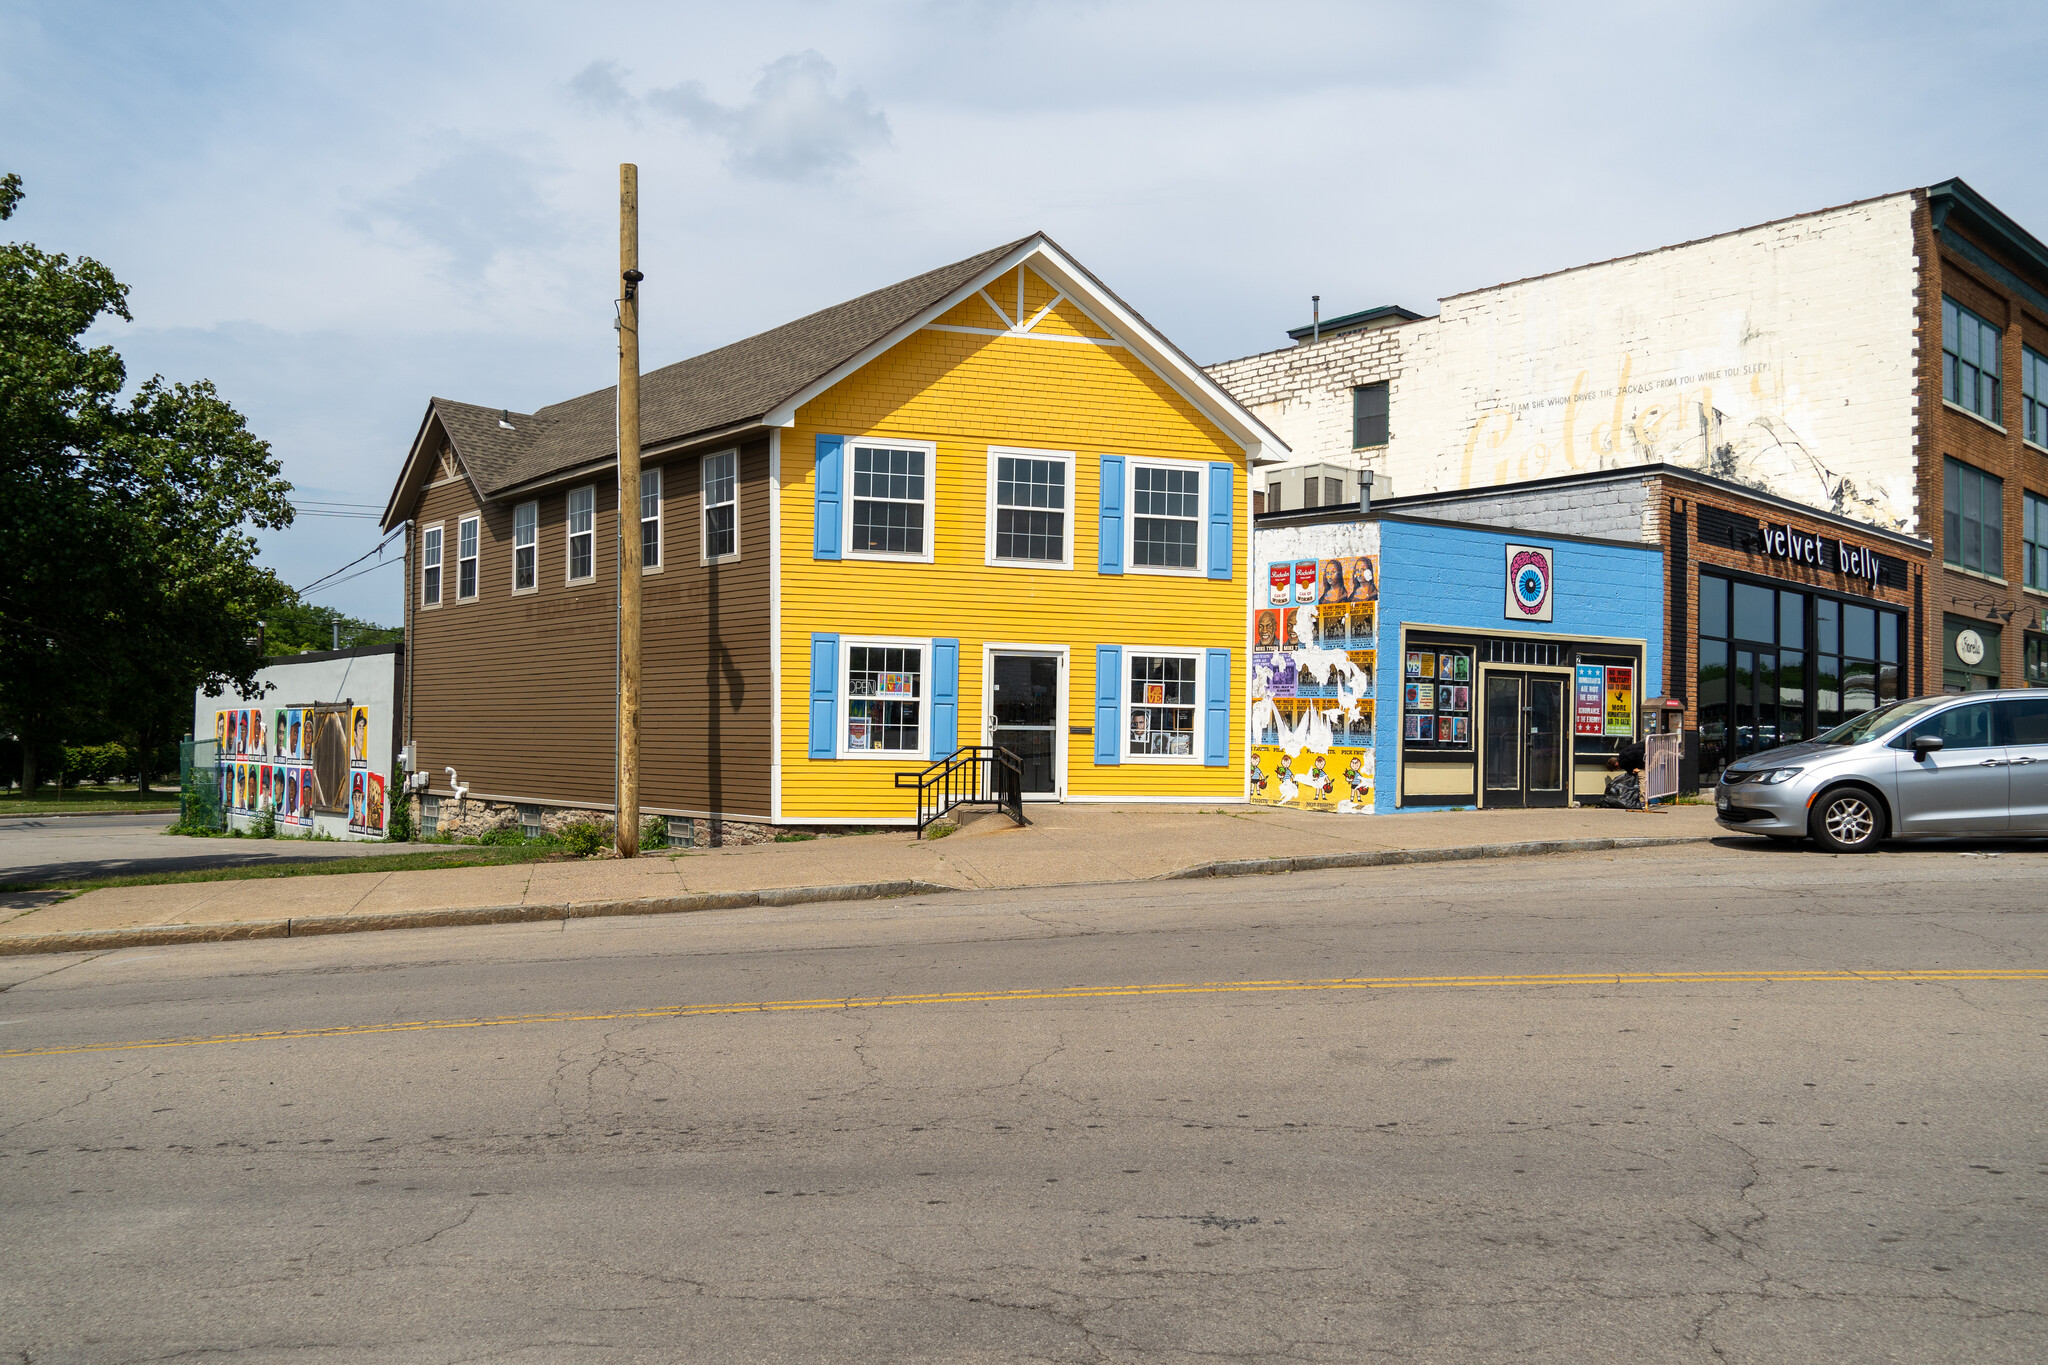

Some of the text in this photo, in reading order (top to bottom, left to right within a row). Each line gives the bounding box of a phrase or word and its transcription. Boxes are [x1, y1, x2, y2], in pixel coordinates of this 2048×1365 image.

[1518, 403, 1529, 411] AM
[1532, 401, 1544, 409] SHE
[1547, 395, 1571, 406] WHOM
[1574, 391, 1596, 402] DRIVES
[1600, 388, 1613, 398] THE
[1617, 382, 1653, 395] JACKALS
[1656, 378, 1677, 388] FROM
[1680, 375, 1695, 385] YOU
[1697, 370, 1721, 382] WHILE
[1724, 367, 1739, 377] YOU
[1763, 524, 1879, 590] velvet belly
[849, 680, 875, 693] OPEN
